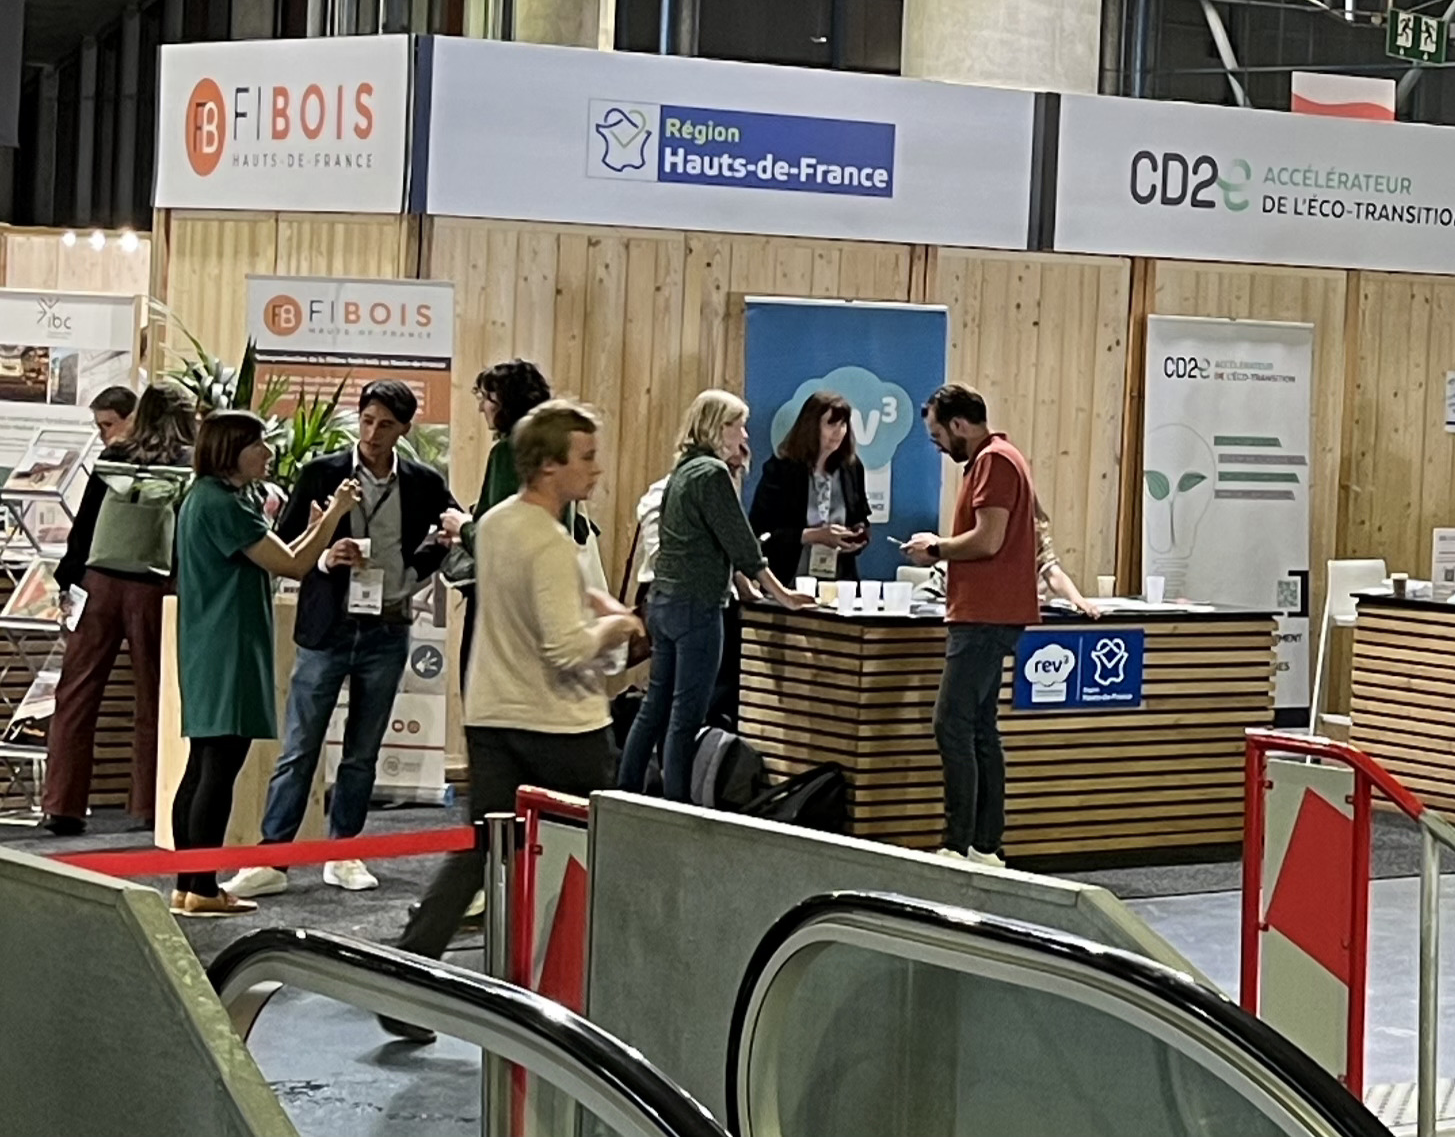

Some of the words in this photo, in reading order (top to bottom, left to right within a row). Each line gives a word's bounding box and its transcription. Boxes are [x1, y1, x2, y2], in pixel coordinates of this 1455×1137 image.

[233, 82, 374, 142] FIBOIS
[664, 118, 741, 145] Région
[663, 146, 890, 189] Hauts-de-France
[1263, 162, 1412, 195] ACCÉLÉRATEUR
[1262, 195, 1288, 215] DE
[309, 299, 433, 328] FIBOIS
